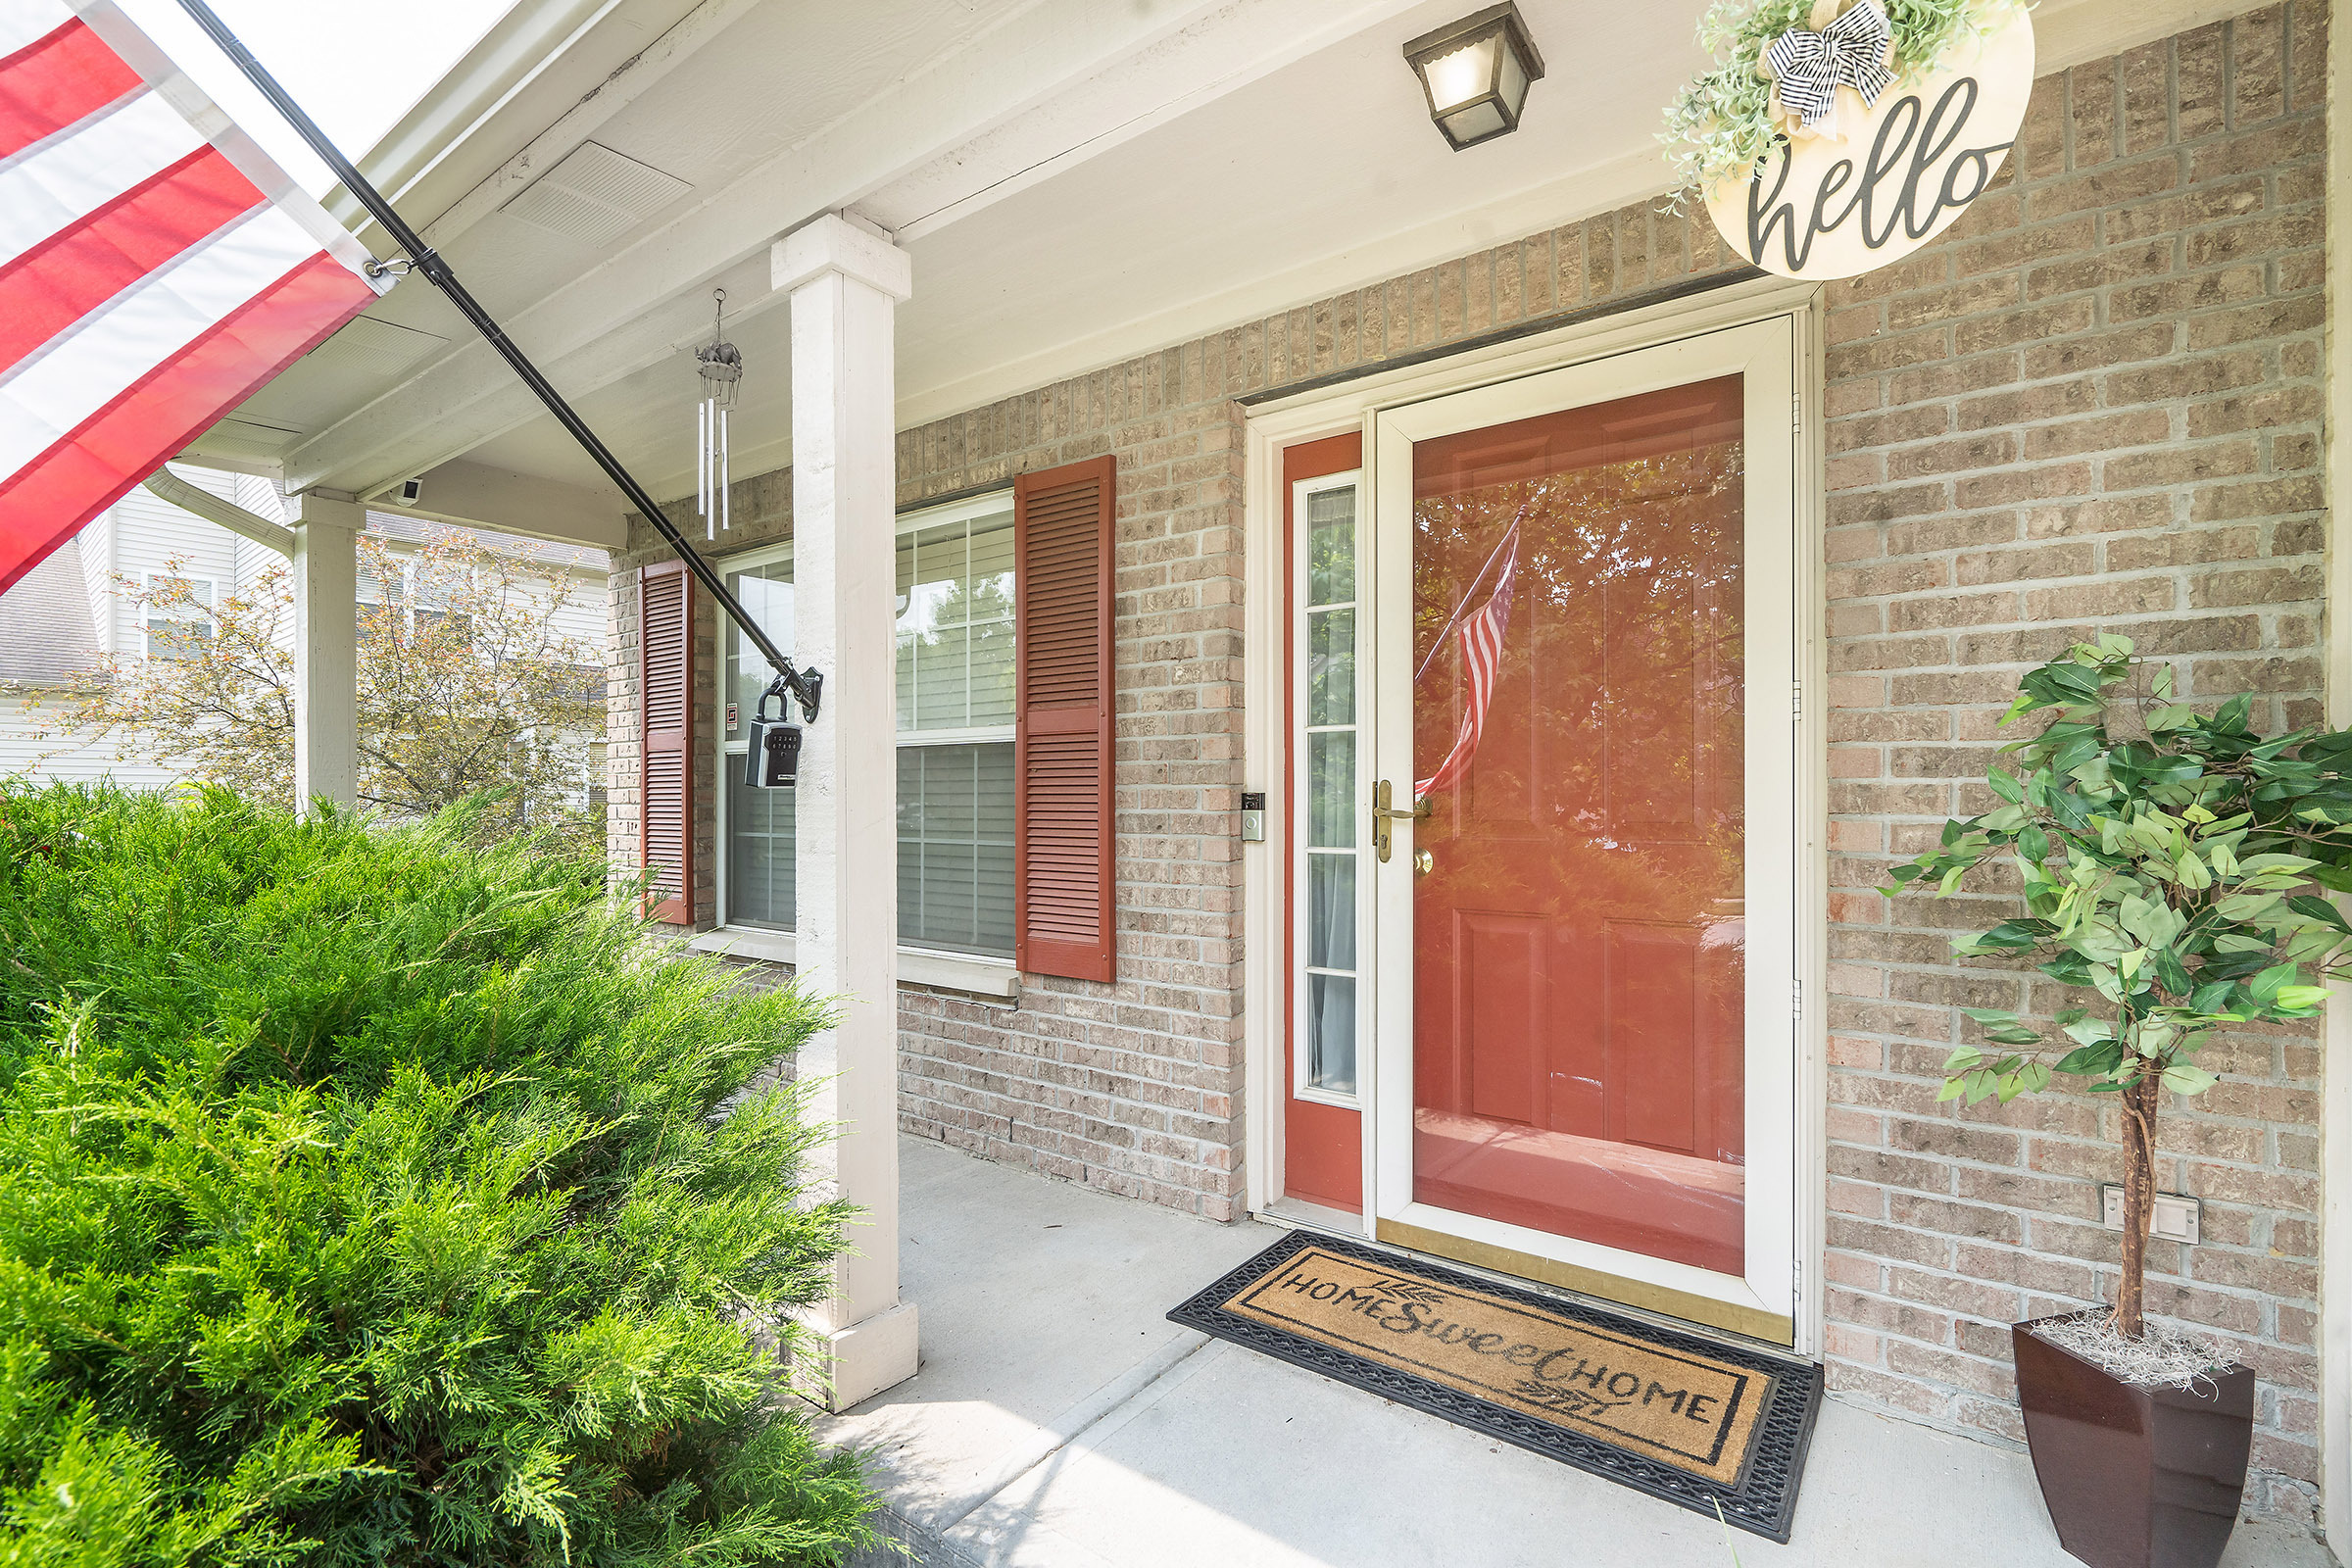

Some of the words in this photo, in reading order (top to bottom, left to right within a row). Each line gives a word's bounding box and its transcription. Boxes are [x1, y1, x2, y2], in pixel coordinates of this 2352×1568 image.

[1747, 76, 2015, 272] hello
[1281, 1274, 1396, 1319] HOME
[1379, 1301, 1575, 1381] Sweet
[1569, 1358, 1719, 1424] HOME
